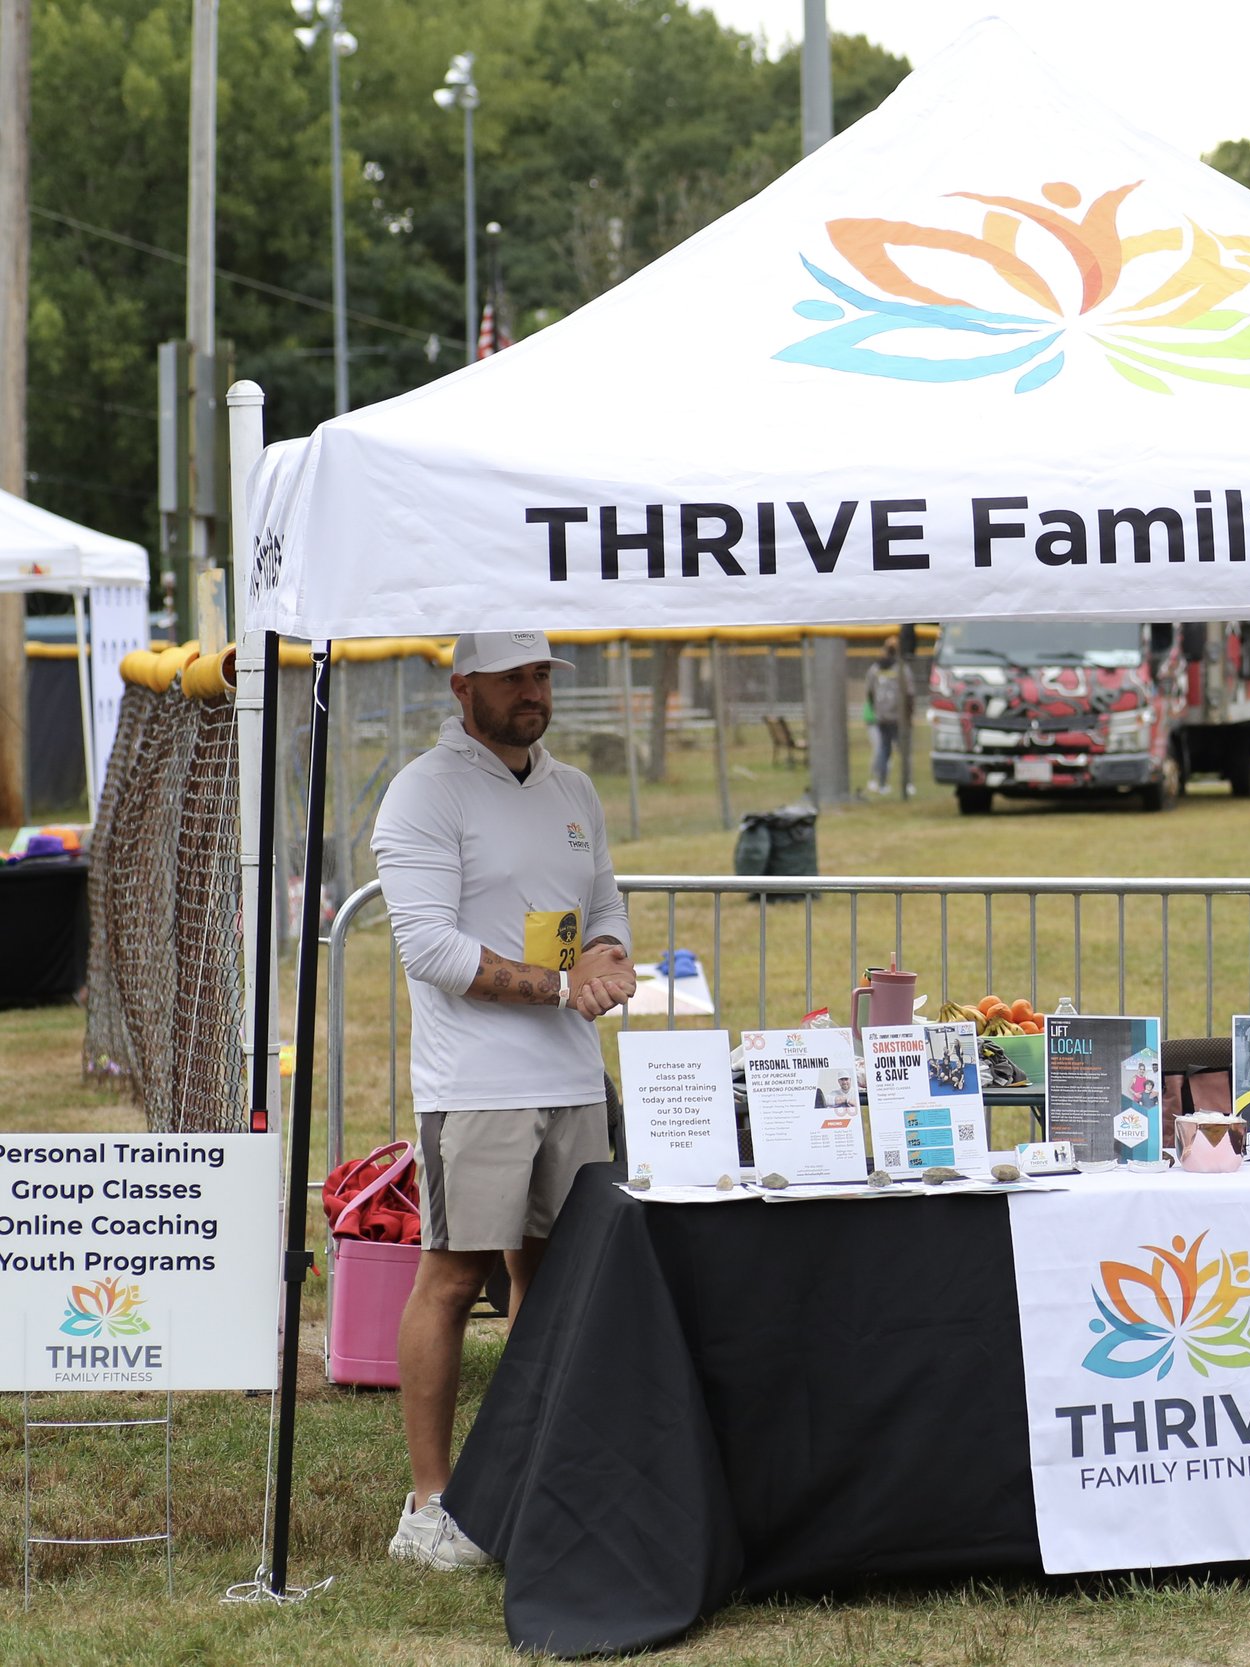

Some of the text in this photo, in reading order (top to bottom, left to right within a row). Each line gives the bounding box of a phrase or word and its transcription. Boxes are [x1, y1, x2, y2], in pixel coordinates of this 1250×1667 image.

[526, 498, 930, 582] THRIVE
[568, 840, 590, 849] THRIVE
[559, 948, 575, 971] 23
[1051, 1025, 1068, 1037] LIFT
[872, 1040, 925, 1053] SAKSTRONG
[1051, 1038, 1092, 1054] LOCAL!
[687, 1062, 702, 1070] any
[749, 1057, 829, 1071] PERSONAL TRAINING
[874, 1055, 921, 1069] JOIN NOW
[876, 1068, 909, 1081] & SAVE
[649, 1083, 683, 1093] personal
[685, 1083, 717, 1092] training
[642, 1096, 665, 1105] today
[684, 1107, 700, 1115] Day
[669, 1118, 711, 1127] Ingredient
[650, 1130, 686, 1138] Nutrition
[670, 1141, 693, 1149] FREE!
[113, 1141, 225, 1168] Training
[11, 1178, 202, 1204] Group Classes
[0, 1213, 218, 1240] Online Coaching
[0, 1251, 216, 1276] Youth Programs
[45, 1345, 163, 1369] THRIVE
[55, 1371, 153, 1383] FAMILY FITNESS
[1080, 1461, 1178, 1490] FAMILY
